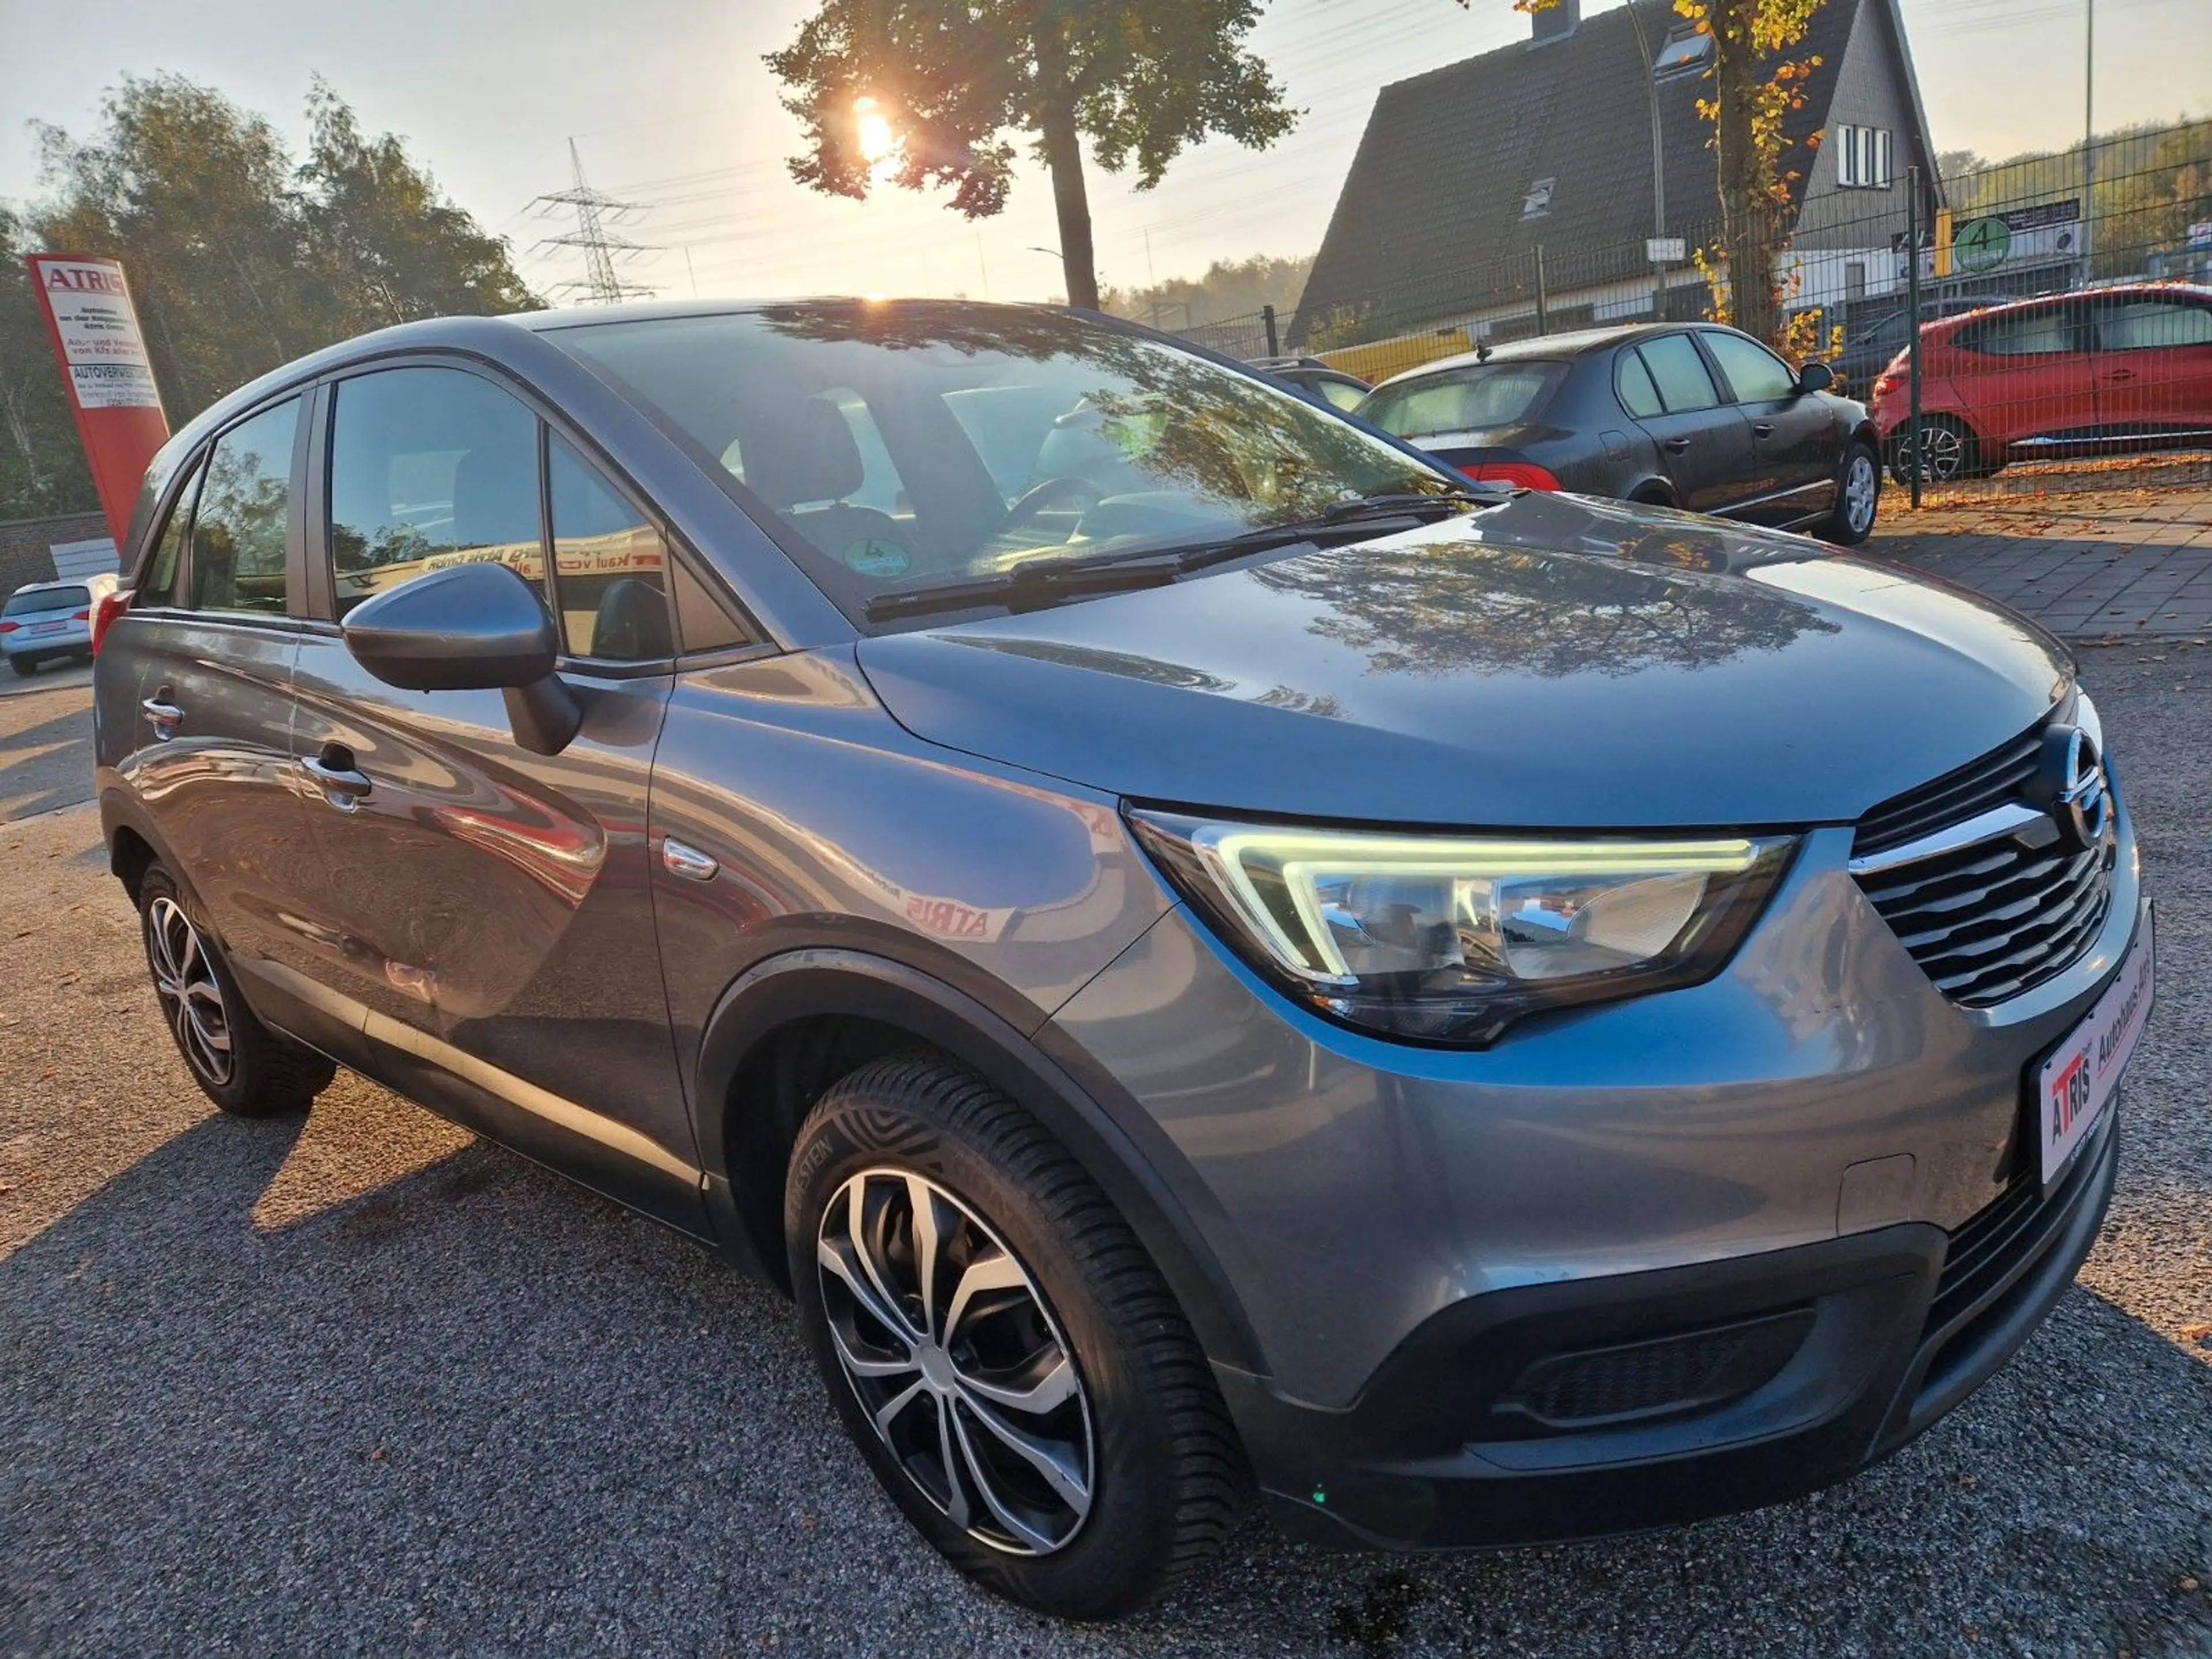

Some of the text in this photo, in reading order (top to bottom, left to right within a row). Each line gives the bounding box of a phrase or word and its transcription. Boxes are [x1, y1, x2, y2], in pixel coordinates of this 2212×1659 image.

[1969, 222, 1989, 251] 4
[48, 268, 124, 291] ATRIS
[2052, 1054, 2090, 1146] ATRIS
[2098, 985, 2138, 1072] Autohaus
